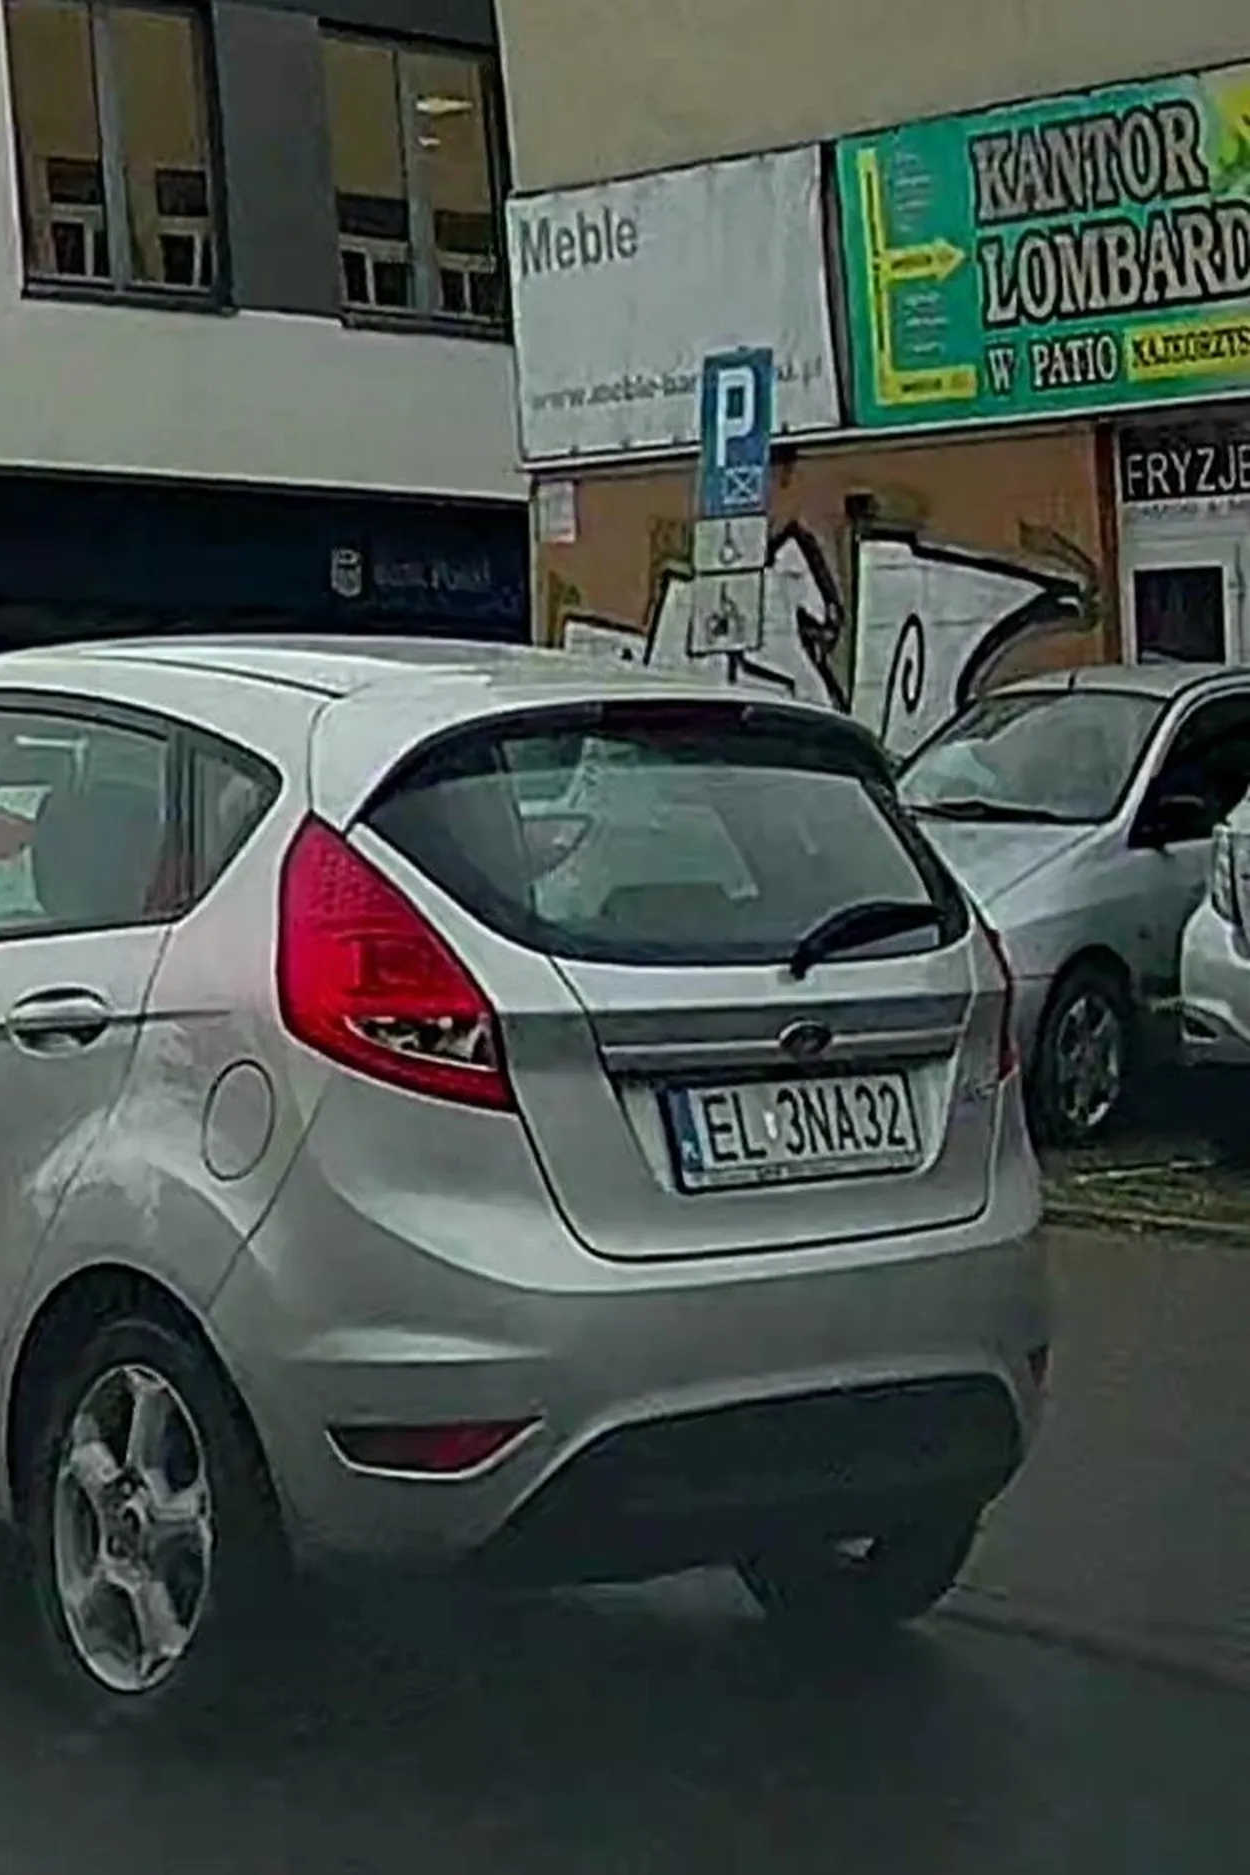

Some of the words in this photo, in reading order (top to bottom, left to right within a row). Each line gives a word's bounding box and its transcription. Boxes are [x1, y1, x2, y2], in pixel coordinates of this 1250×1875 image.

[972, 102, 1207, 222] KANTOR
[520, 207, 638, 276] Meble
[979, 205, 1250, 324] LOMBARD
[989, 345, 1014, 390] W
[1034, 333, 1117, 388] PATIO
[716, 366, 755, 468] P
[1127, 443, 1250, 496] FRYZJE
[702, 1091, 767, 1163] EL
[776, 1083, 906, 1156] 3NA32
